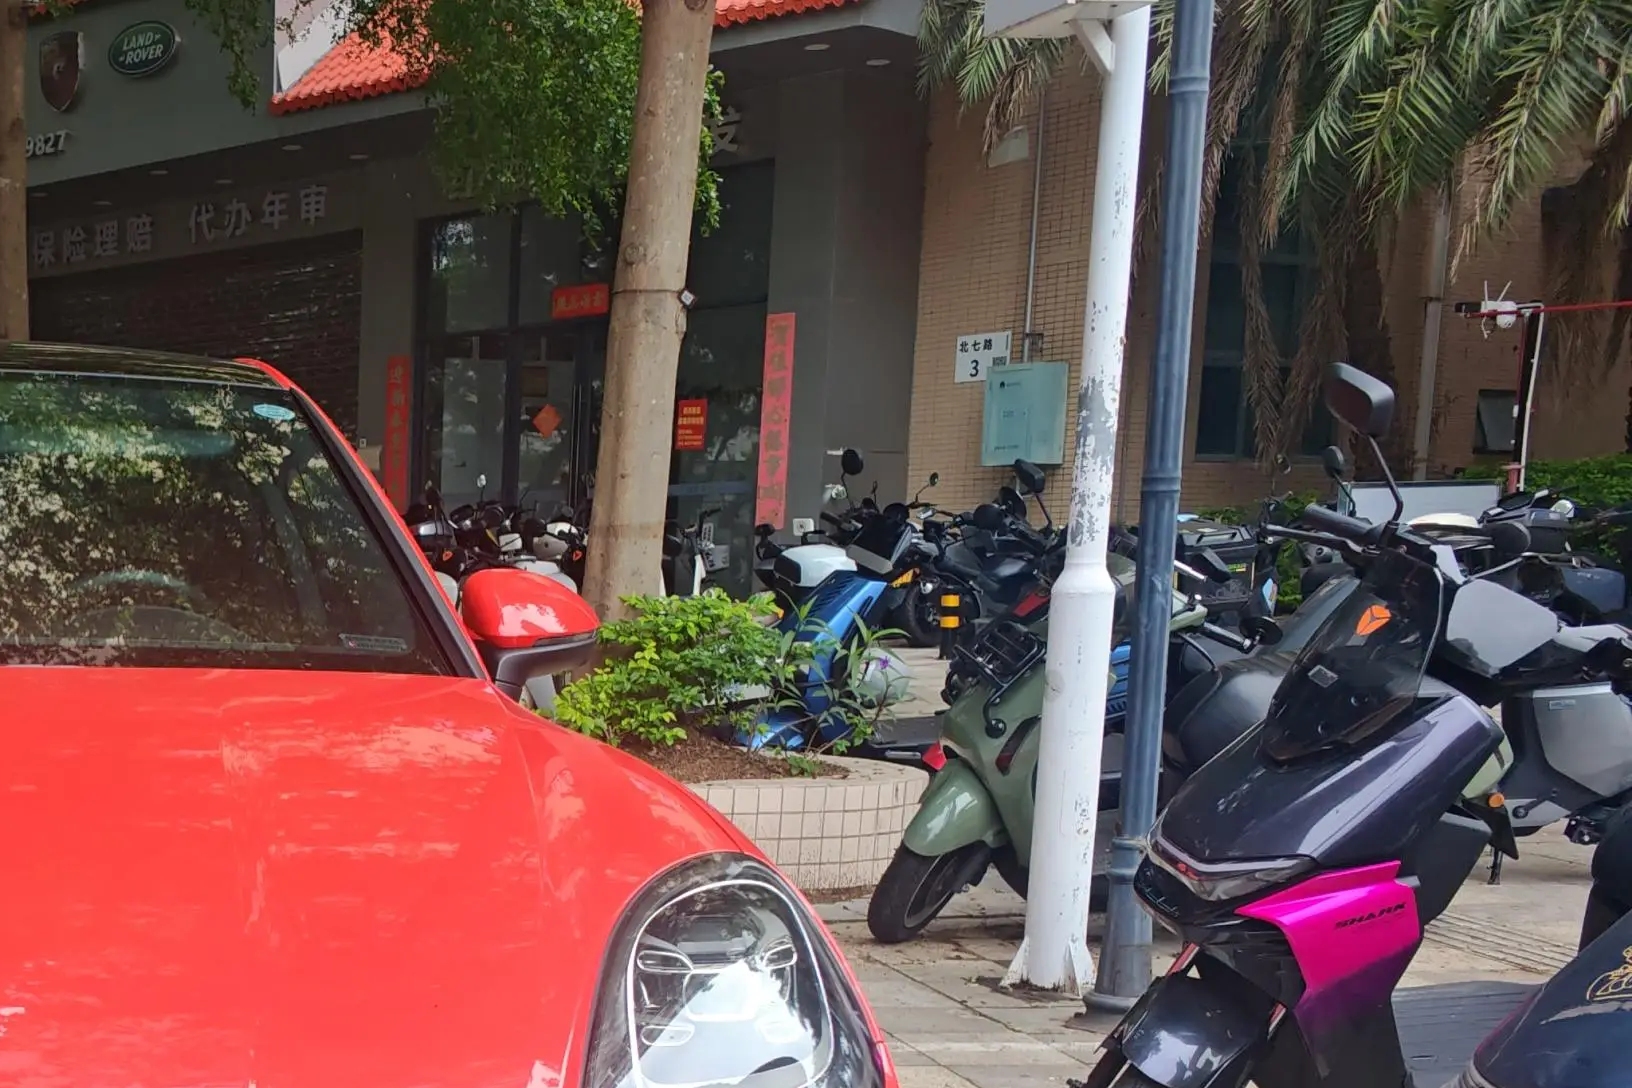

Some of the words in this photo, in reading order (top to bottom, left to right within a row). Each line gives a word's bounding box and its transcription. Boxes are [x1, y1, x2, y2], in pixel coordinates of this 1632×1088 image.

[122, 31, 154, 51] LAND
[125, 43, 164, 65] ROVER
[33, 213, 154, 267] 保险理赔
[188, 184, 328, 245] 代办年审
[959, 338, 993, 353] 北七路
[969, 359, 980, 378] 3
